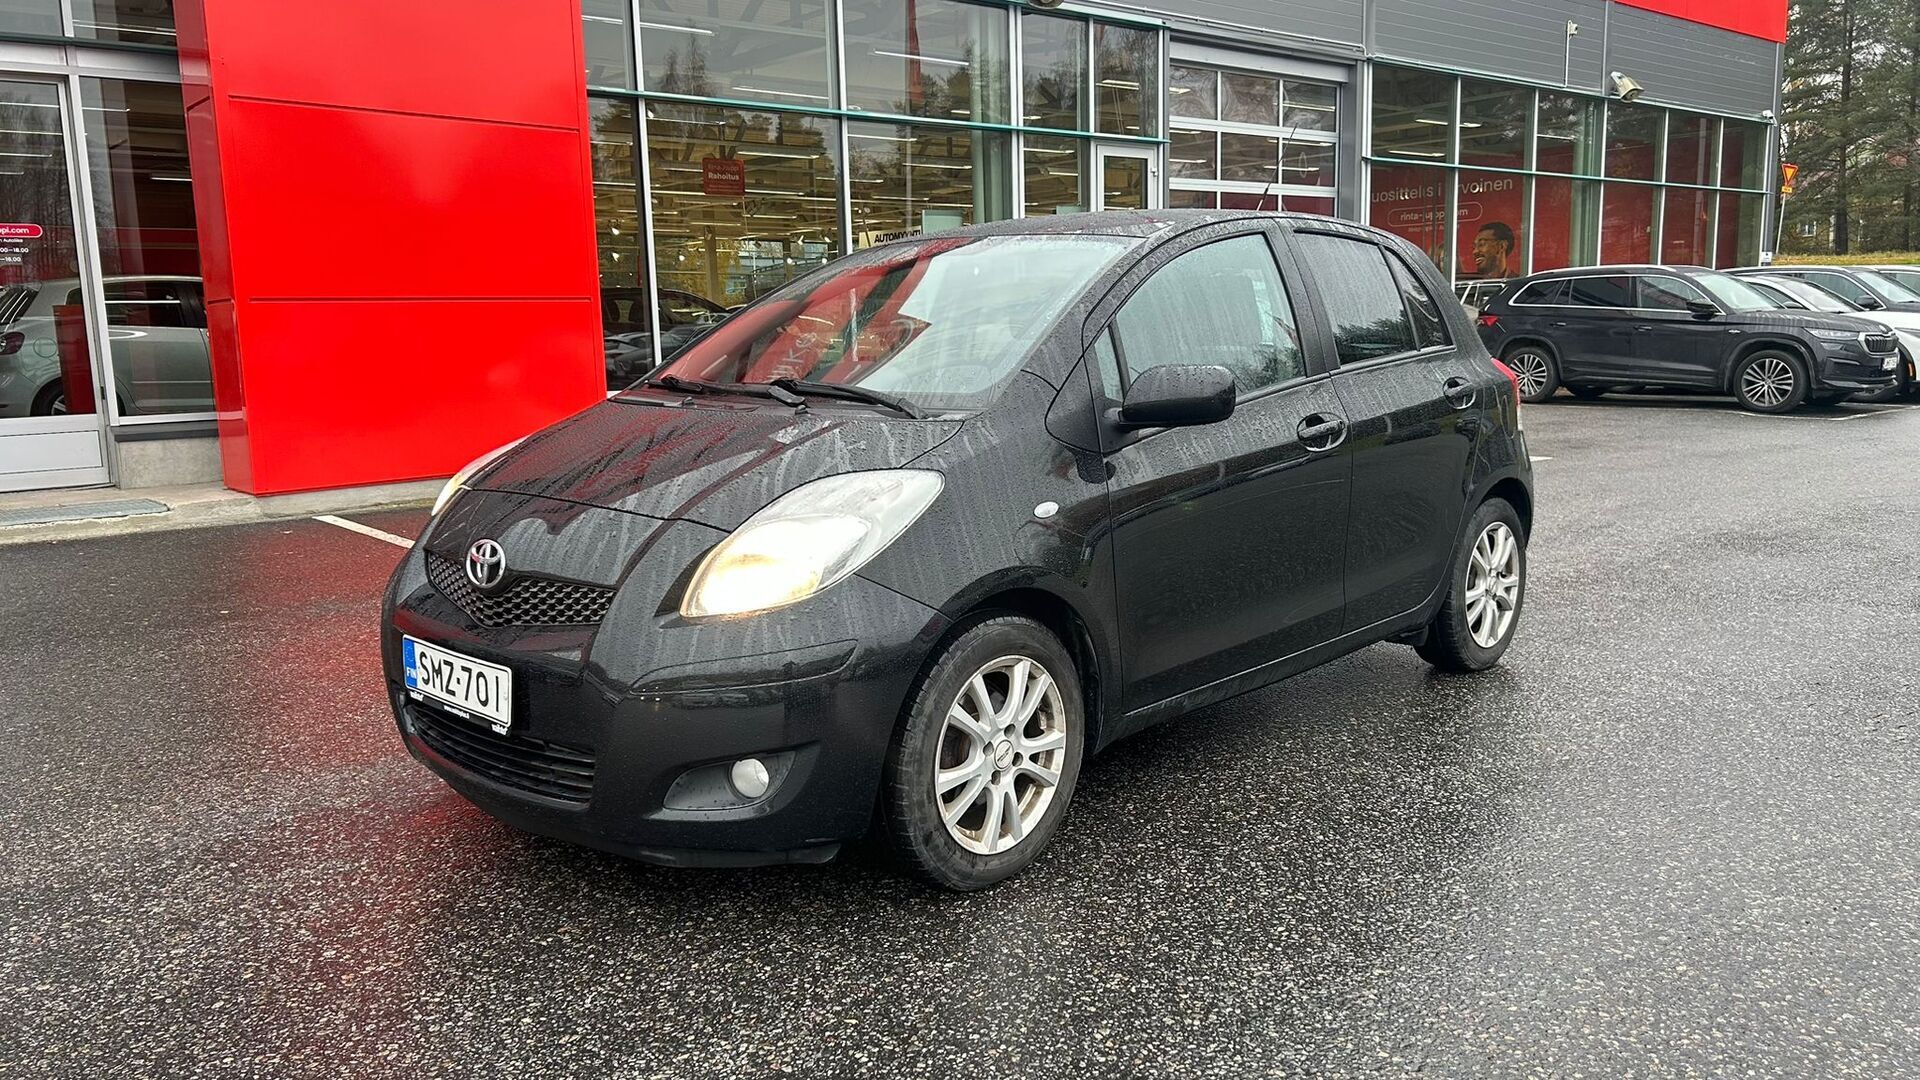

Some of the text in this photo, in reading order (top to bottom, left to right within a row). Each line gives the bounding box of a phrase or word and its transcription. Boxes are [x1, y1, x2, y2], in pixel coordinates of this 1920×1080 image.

[708, 172, 740, 180] Rahoitus
[1457, 177, 1513, 194] voinen
[419, 651, 500, 713] SMZ-701
